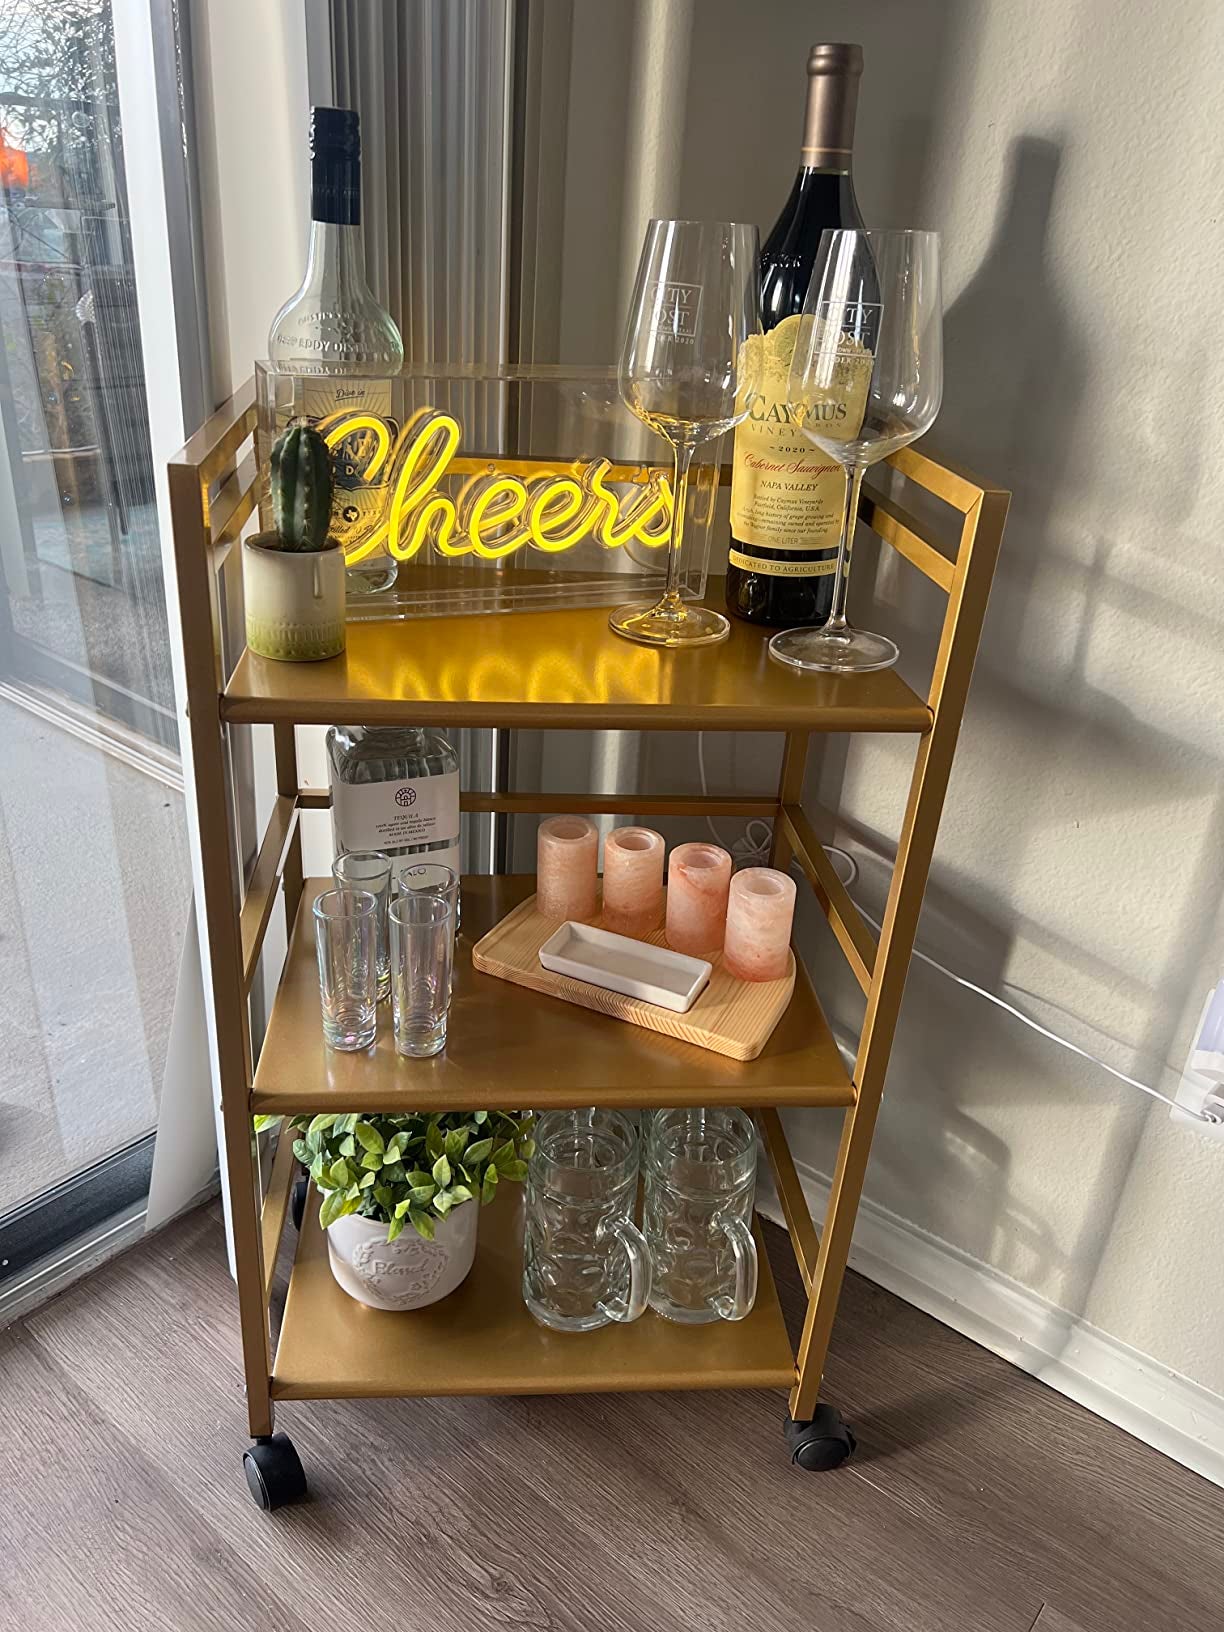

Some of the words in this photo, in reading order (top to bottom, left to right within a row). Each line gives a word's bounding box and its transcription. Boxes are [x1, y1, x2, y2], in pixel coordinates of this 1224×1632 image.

[651, 287, 692, 304] CTY
[744, 452, 785, 473] Cabernet
[786, 458, 841, 480] Sauvignon
[760, 480, 782, 490] NAPA
[784, 482, 818, 491] VALLEY
[782, 562, 834, 573] AGRICULTURE
